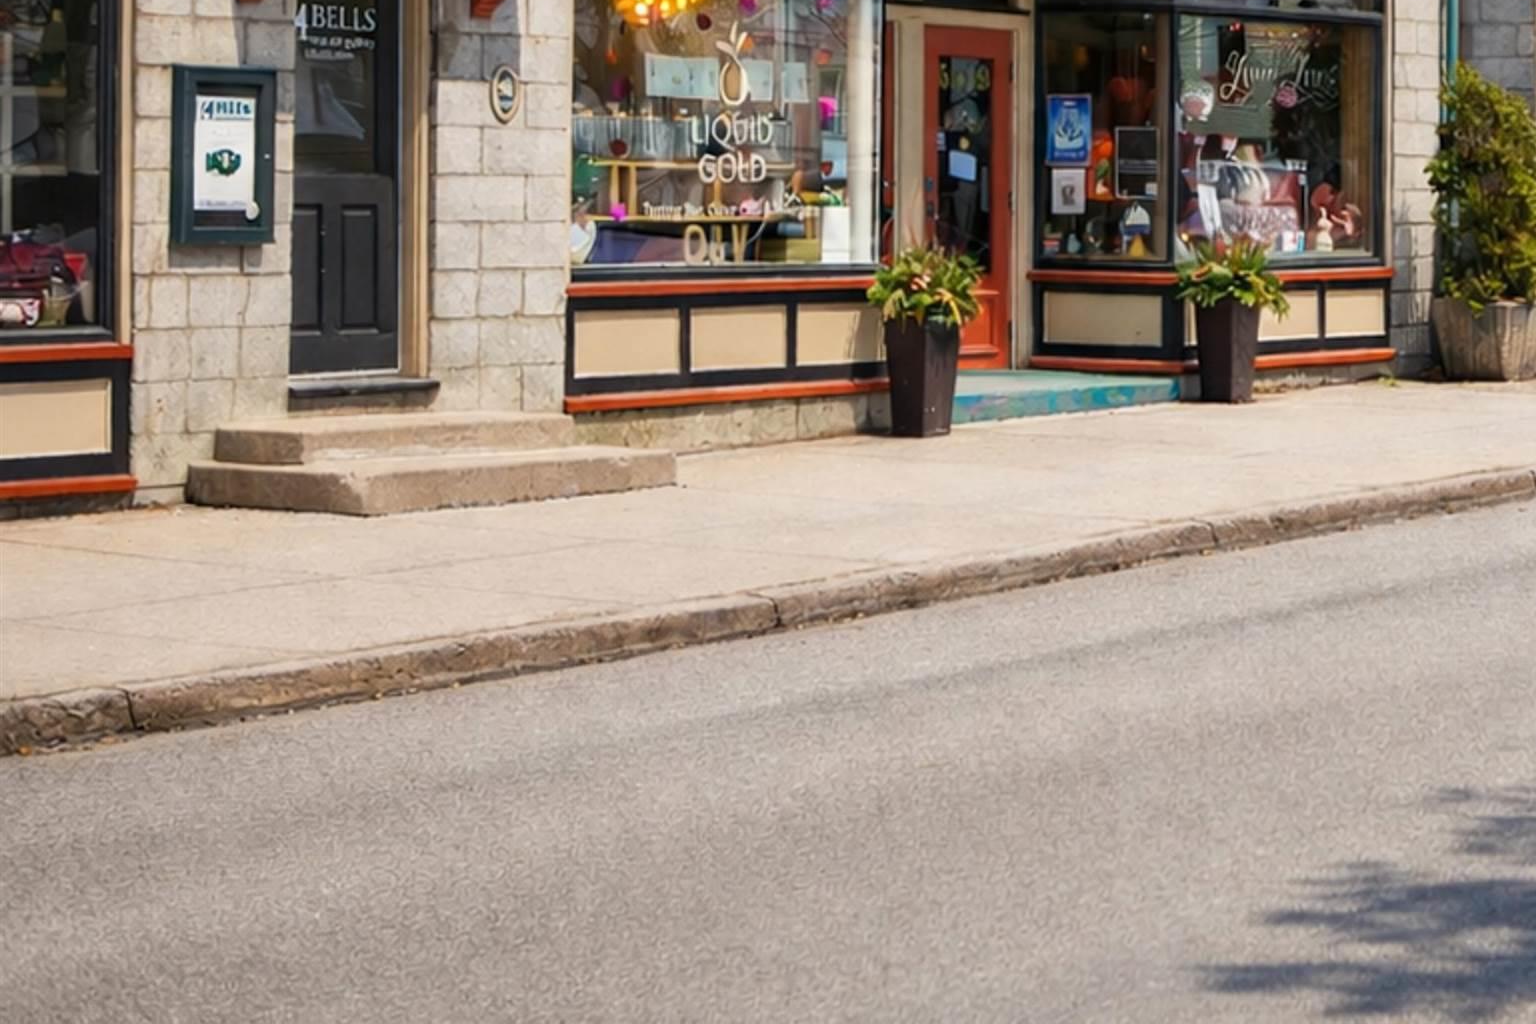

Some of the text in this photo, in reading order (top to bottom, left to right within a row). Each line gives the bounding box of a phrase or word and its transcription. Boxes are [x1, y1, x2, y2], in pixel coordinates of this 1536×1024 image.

[311, 3, 377, 32] BELLS
[690, 110, 774, 152] LIQUID
[698, 151, 767, 184] GOLD
